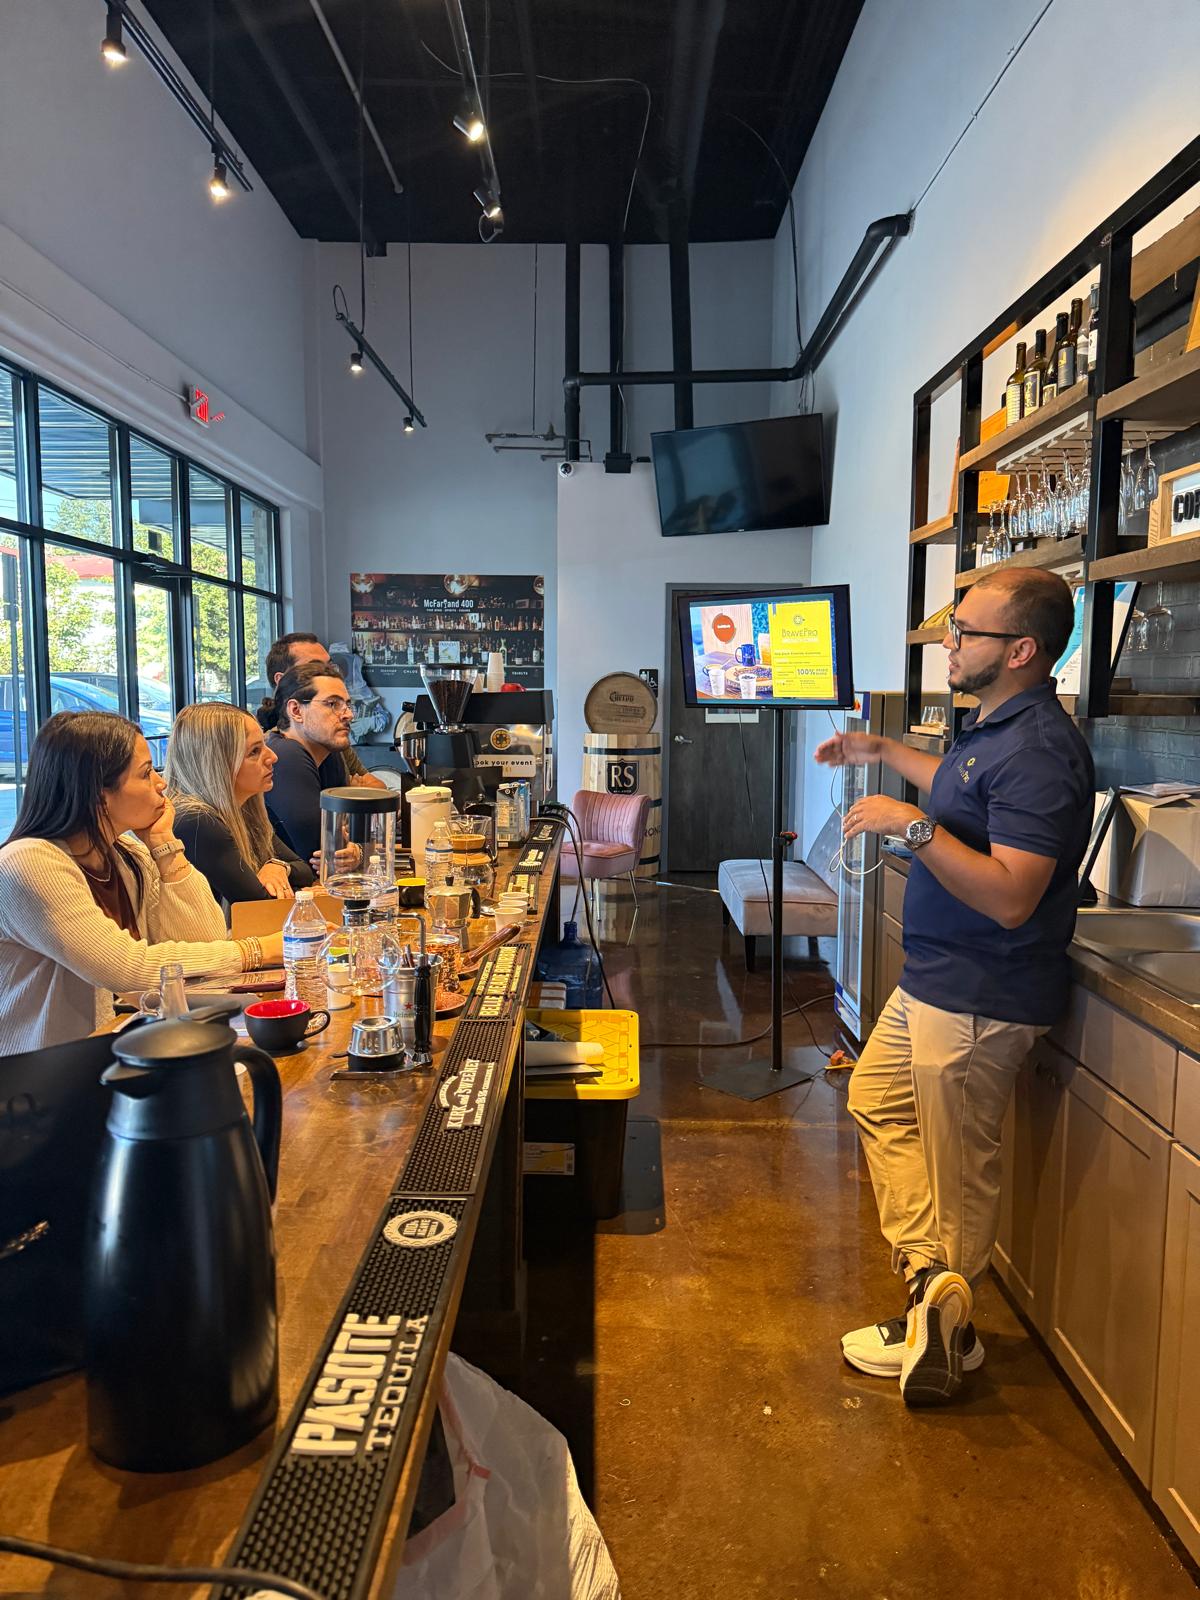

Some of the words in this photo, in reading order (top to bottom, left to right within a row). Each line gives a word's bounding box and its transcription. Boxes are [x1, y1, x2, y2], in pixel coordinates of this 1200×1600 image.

[460, 599, 474, 608] 400
[796, 668, 816, 676] 100%
[610, 765, 635, 788] RS
[478, 995, 504, 1017] BELLE
[454, 1058, 480, 1096] SWEENEY
[446, 1105, 474, 1129] KIRK
[291, 1312, 402, 1457] PASOTE
[364, 1314, 429, 1451] TEQUILA
